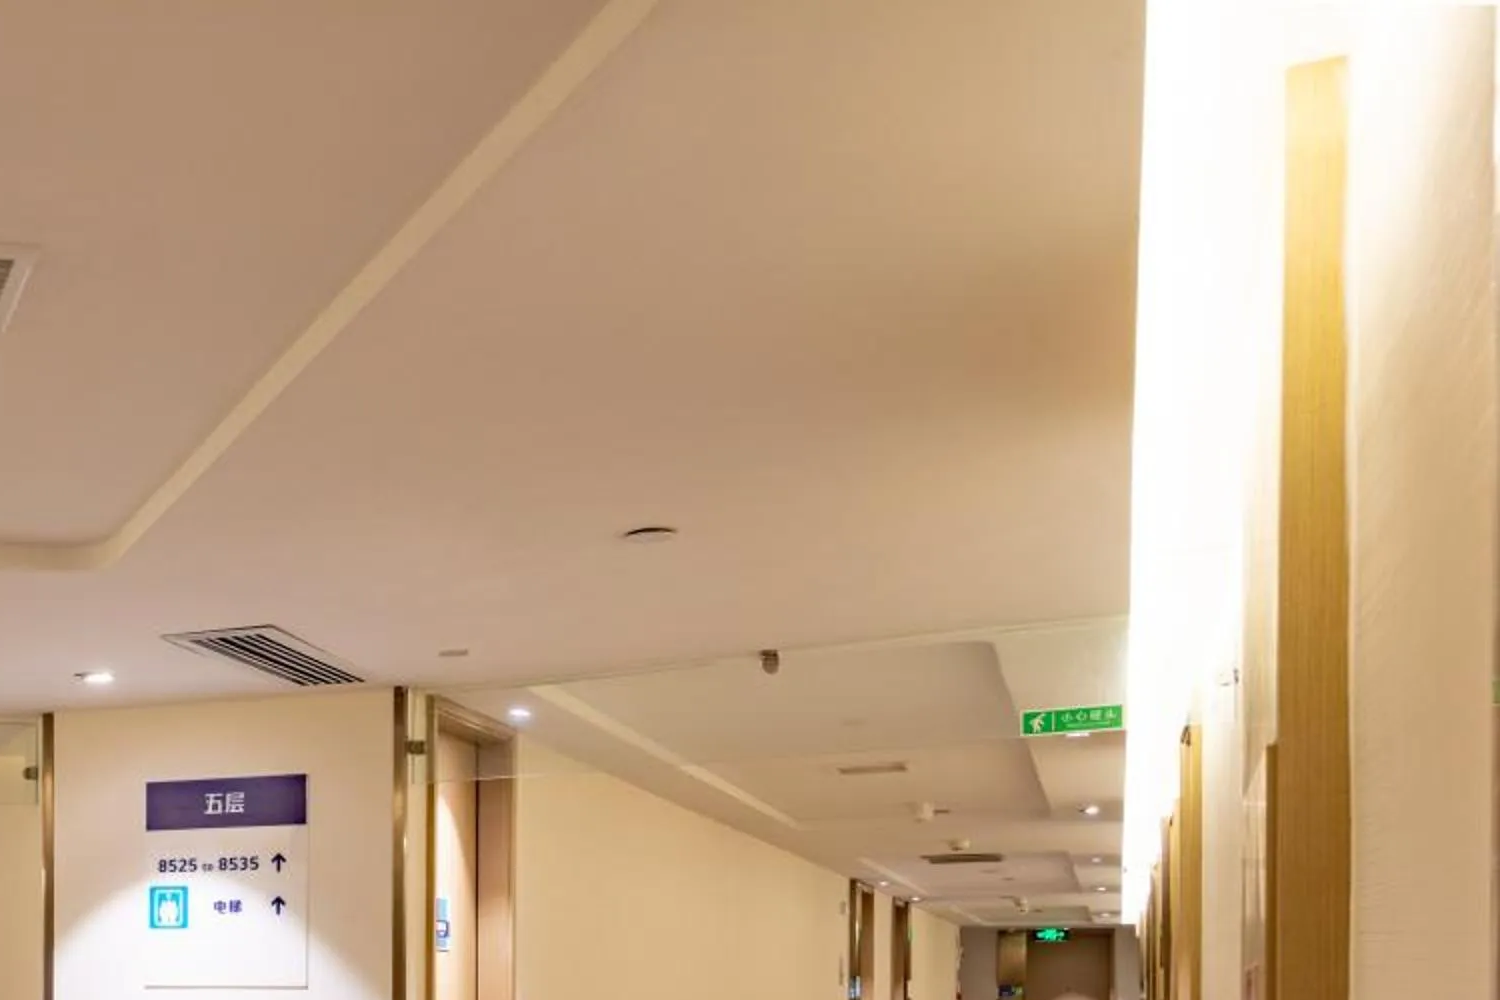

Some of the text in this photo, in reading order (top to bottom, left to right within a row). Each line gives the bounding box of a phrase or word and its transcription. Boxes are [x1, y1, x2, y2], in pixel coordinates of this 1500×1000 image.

[204, 791, 245, 815] 五层
[158, 858, 198, 873] 8525
[218, 856, 259, 871] 8535
[213, 899, 242, 914] 电梯
